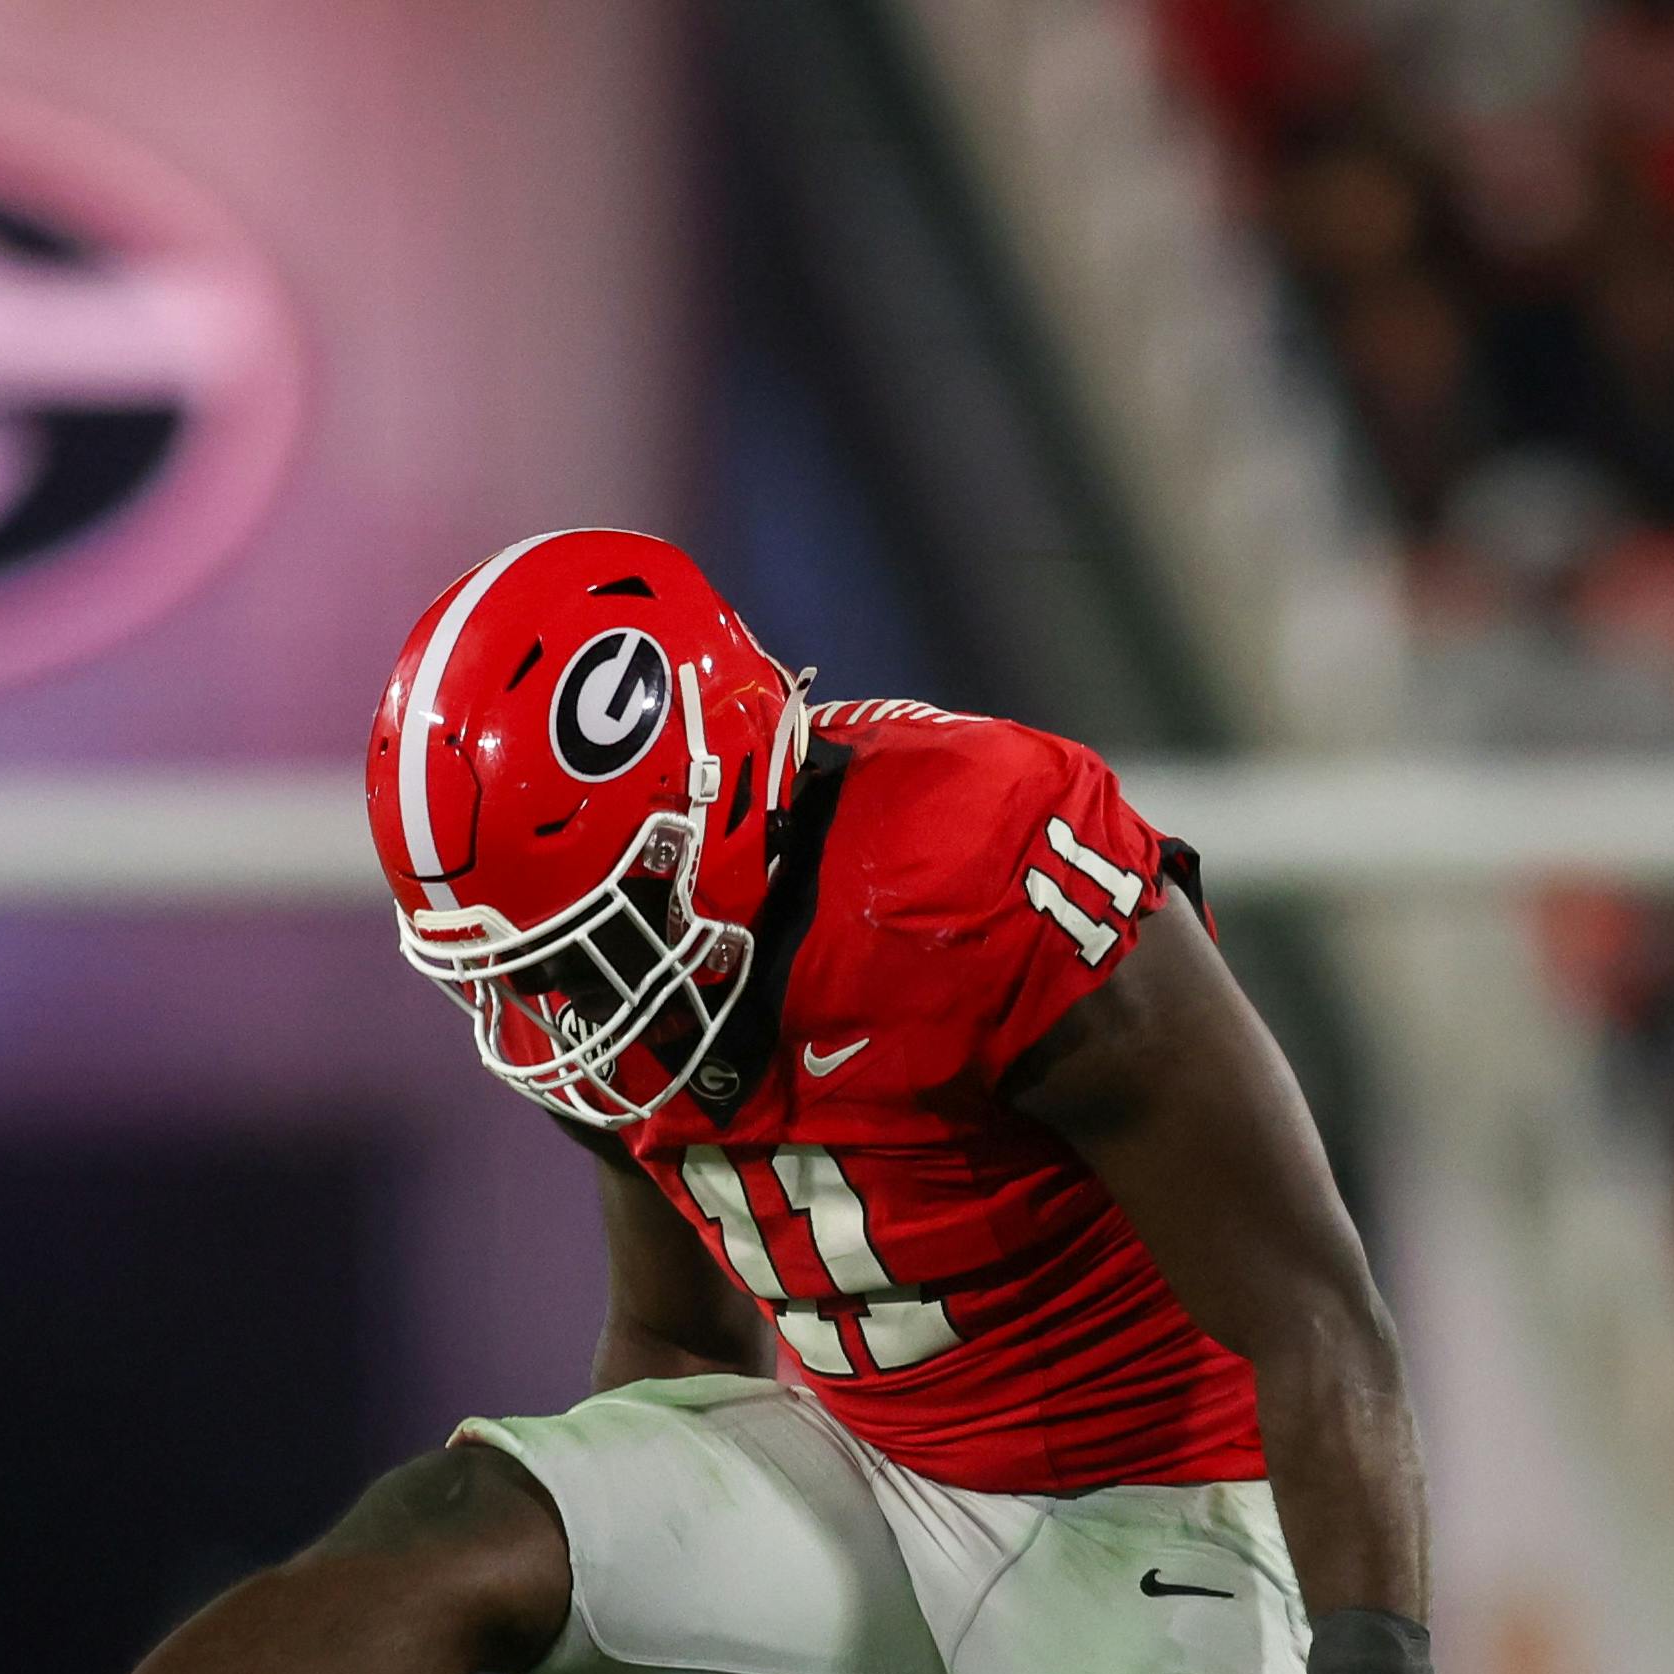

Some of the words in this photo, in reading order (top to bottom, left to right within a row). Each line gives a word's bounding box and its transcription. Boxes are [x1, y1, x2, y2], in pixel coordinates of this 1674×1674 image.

[555, 632, 667, 777] G
[1024, 815, 1145, 968] 11
[680, 1142, 965, 1376] 11
